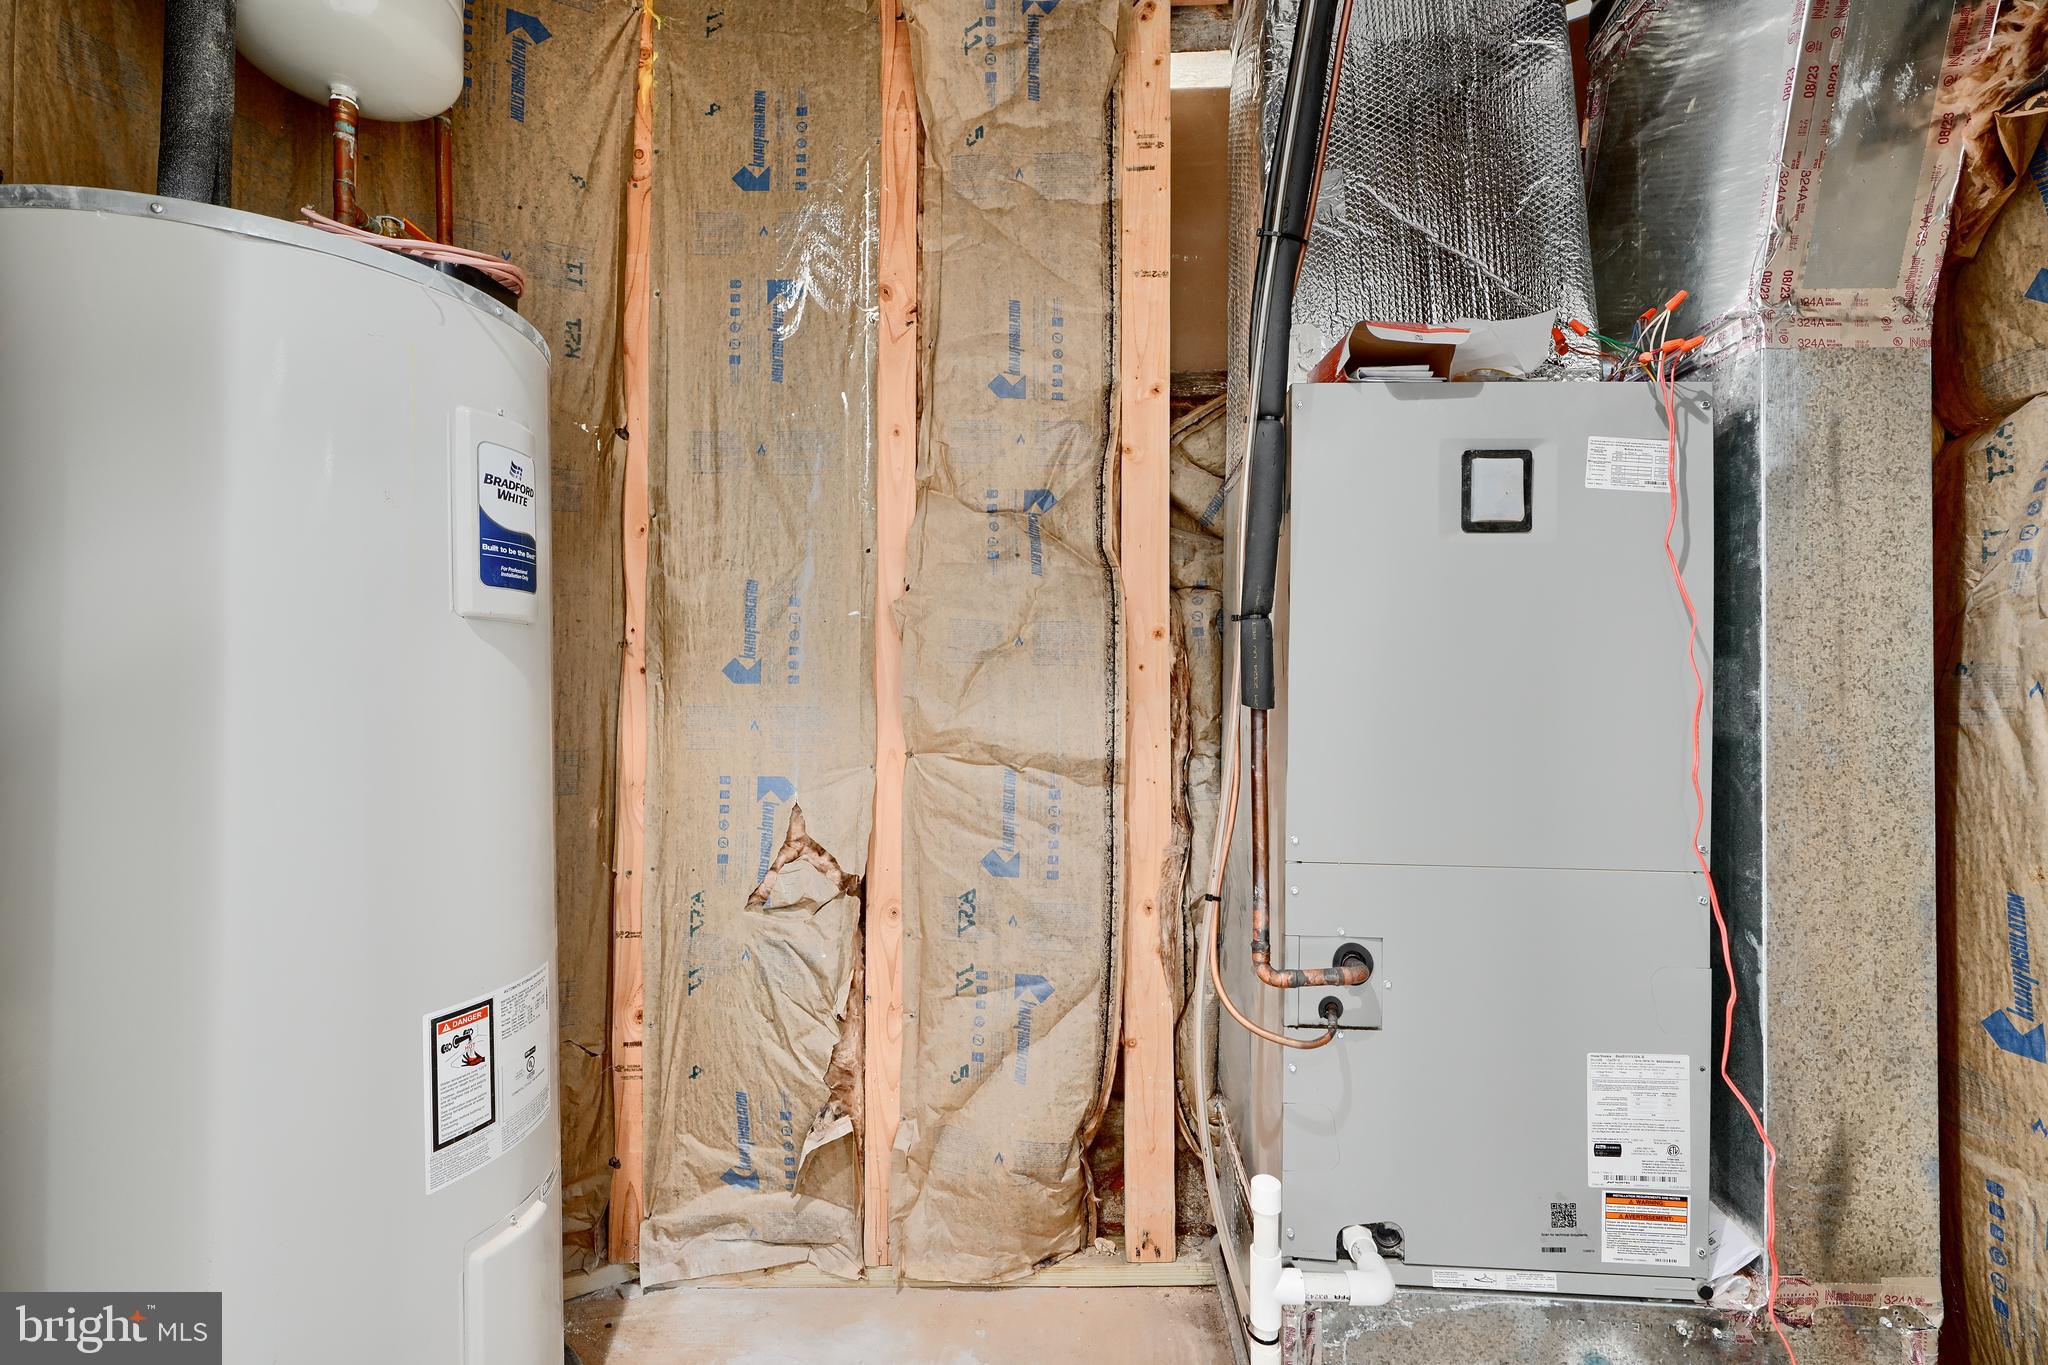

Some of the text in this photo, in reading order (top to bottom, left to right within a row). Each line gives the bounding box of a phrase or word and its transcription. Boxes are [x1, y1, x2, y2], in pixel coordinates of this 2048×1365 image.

[1782, 67, 1796, 101] 08/23
[1803, 65, 1819, 98] 08/23
[1938, 112, 1955, 144] 08/23
[1798, 170, 1812, 203] 324A
[1780, 270, 1793, 300] 08/23
[1797, 317, 1825, 327] 324A
[1797, 338, 1825, 348] 324A
[484, 473, 535, 498] BRADFORD
[497, 488, 528, 507] WHITE
[482, 543, 499, 553] Built
[508, 548, 517, 556] be
[452, 1011, 482, 1028] DANGER
[464, 1042, 476, 1051] HOT
[1824, 1288, 1876, 1302] Nashua
